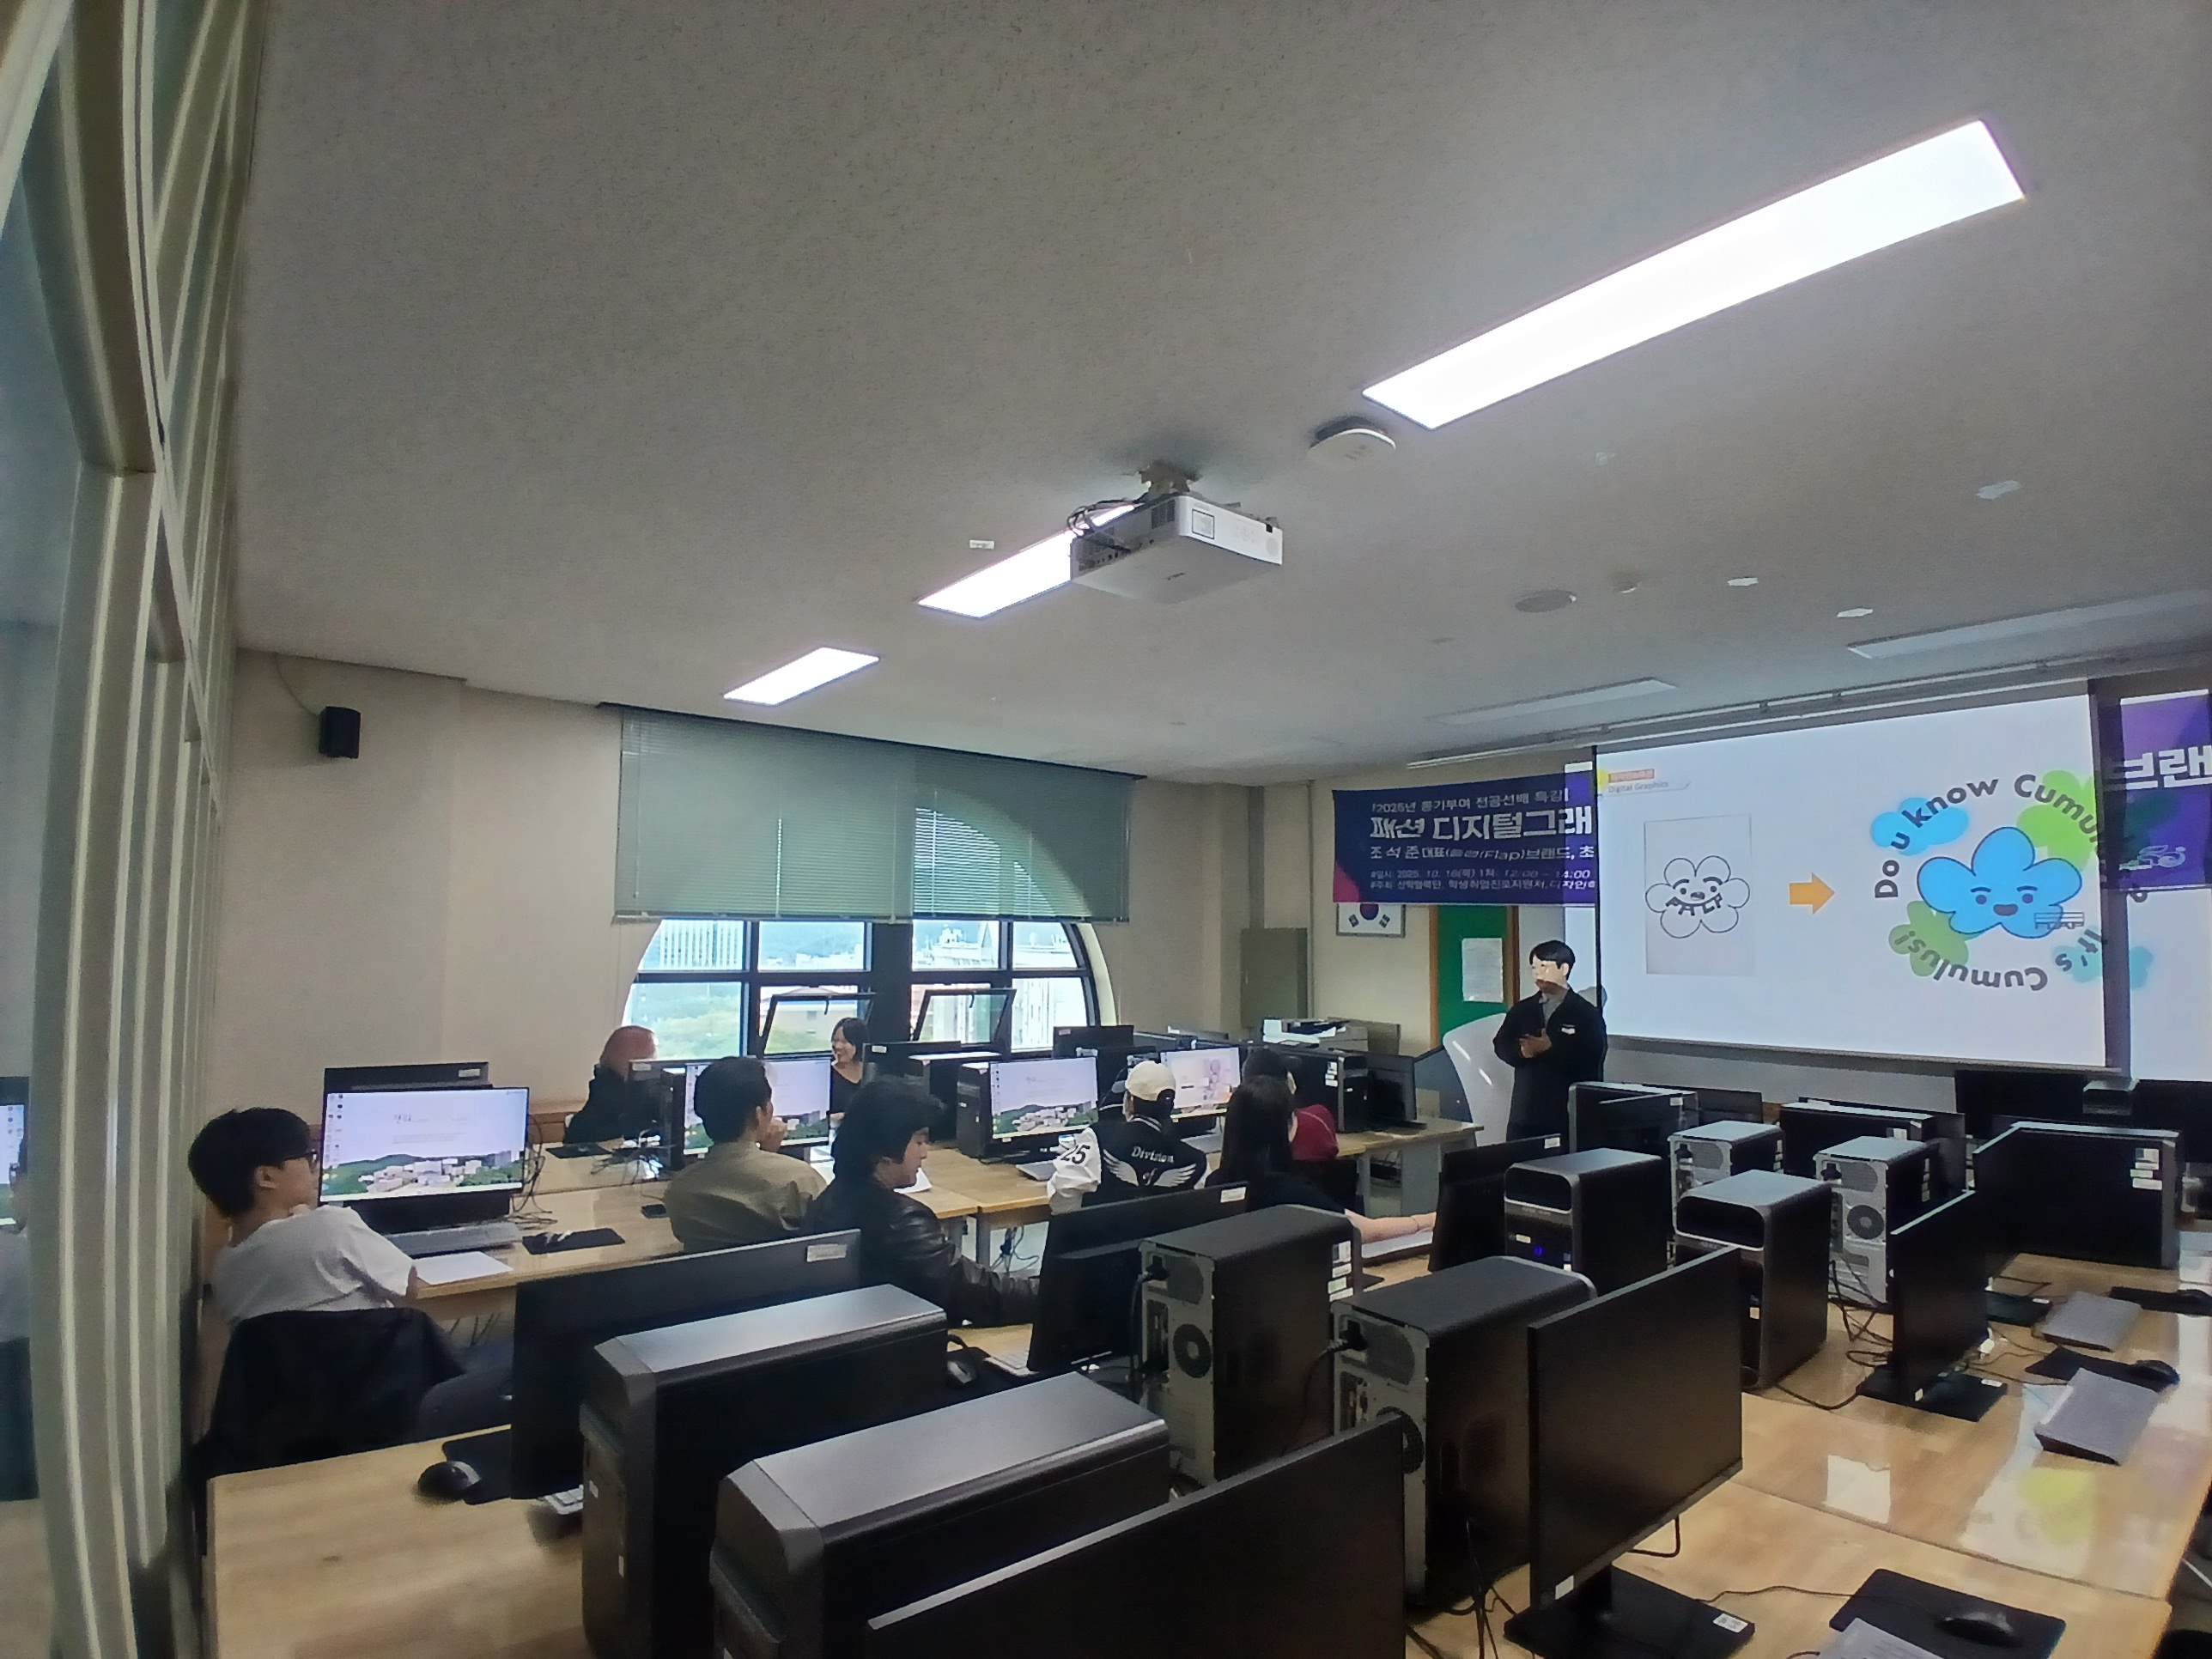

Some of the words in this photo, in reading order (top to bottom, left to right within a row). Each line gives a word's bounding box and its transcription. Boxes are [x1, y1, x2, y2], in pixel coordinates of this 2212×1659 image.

[1608, 783, 1632, 793] Digital
[1634, 781, 1669, 790] Graphics
[1370, 817, 1425, 839] 패션
[1432, 805, 1592, 841] 디지털그래
[1875, 860, 1899, 897] Do
[1891, 831, 1911, 850] u
[1901, 779, 1999, 828] know
[1370, 846, 1382, 859] 조
[1386, 846, 1401, 858] 석
[1060, 1144, 1091, 1164] 25
[1131, 1146, 1175, 1164] Division
